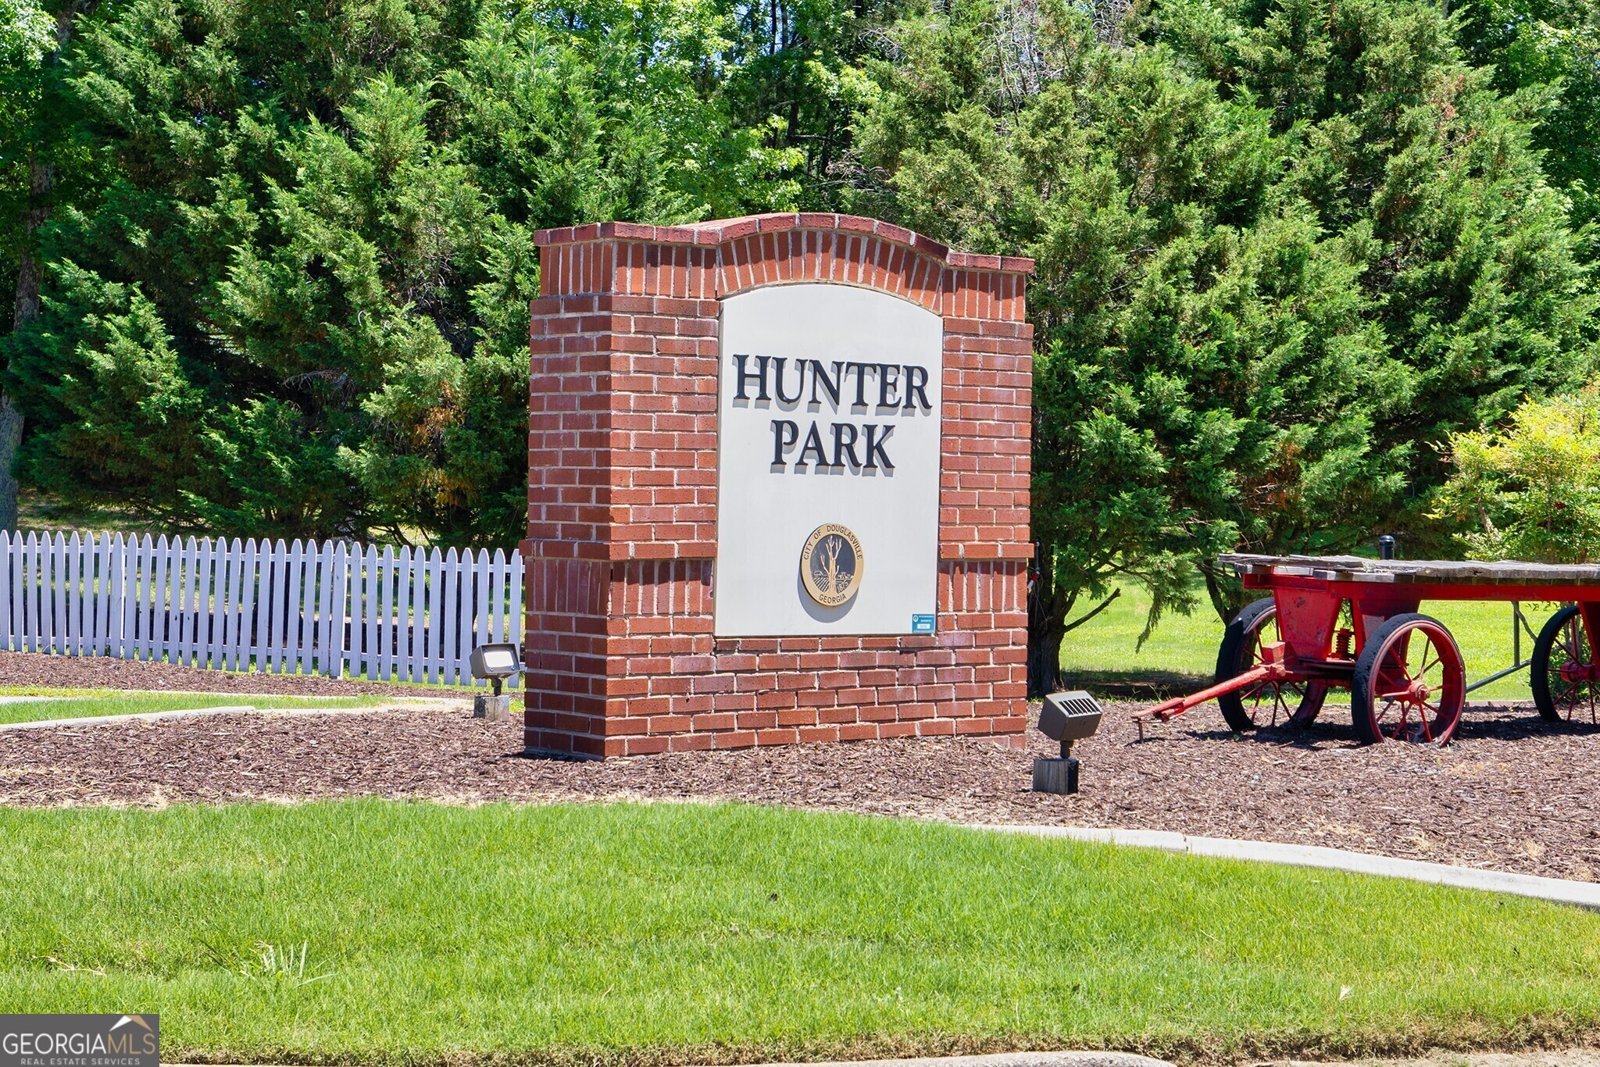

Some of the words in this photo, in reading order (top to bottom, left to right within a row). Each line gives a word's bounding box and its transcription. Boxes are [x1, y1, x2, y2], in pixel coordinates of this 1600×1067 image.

[733, 354, 932, 409] HUNTER
[771, 419, 896, 469] PARK
[804, 541, 814, 560] CITY
[813, 529, 822, 540] OF
[826, 524, 863, 560] DOUGLASVILLE
[819, 593, 847, 604] GEORGIA
